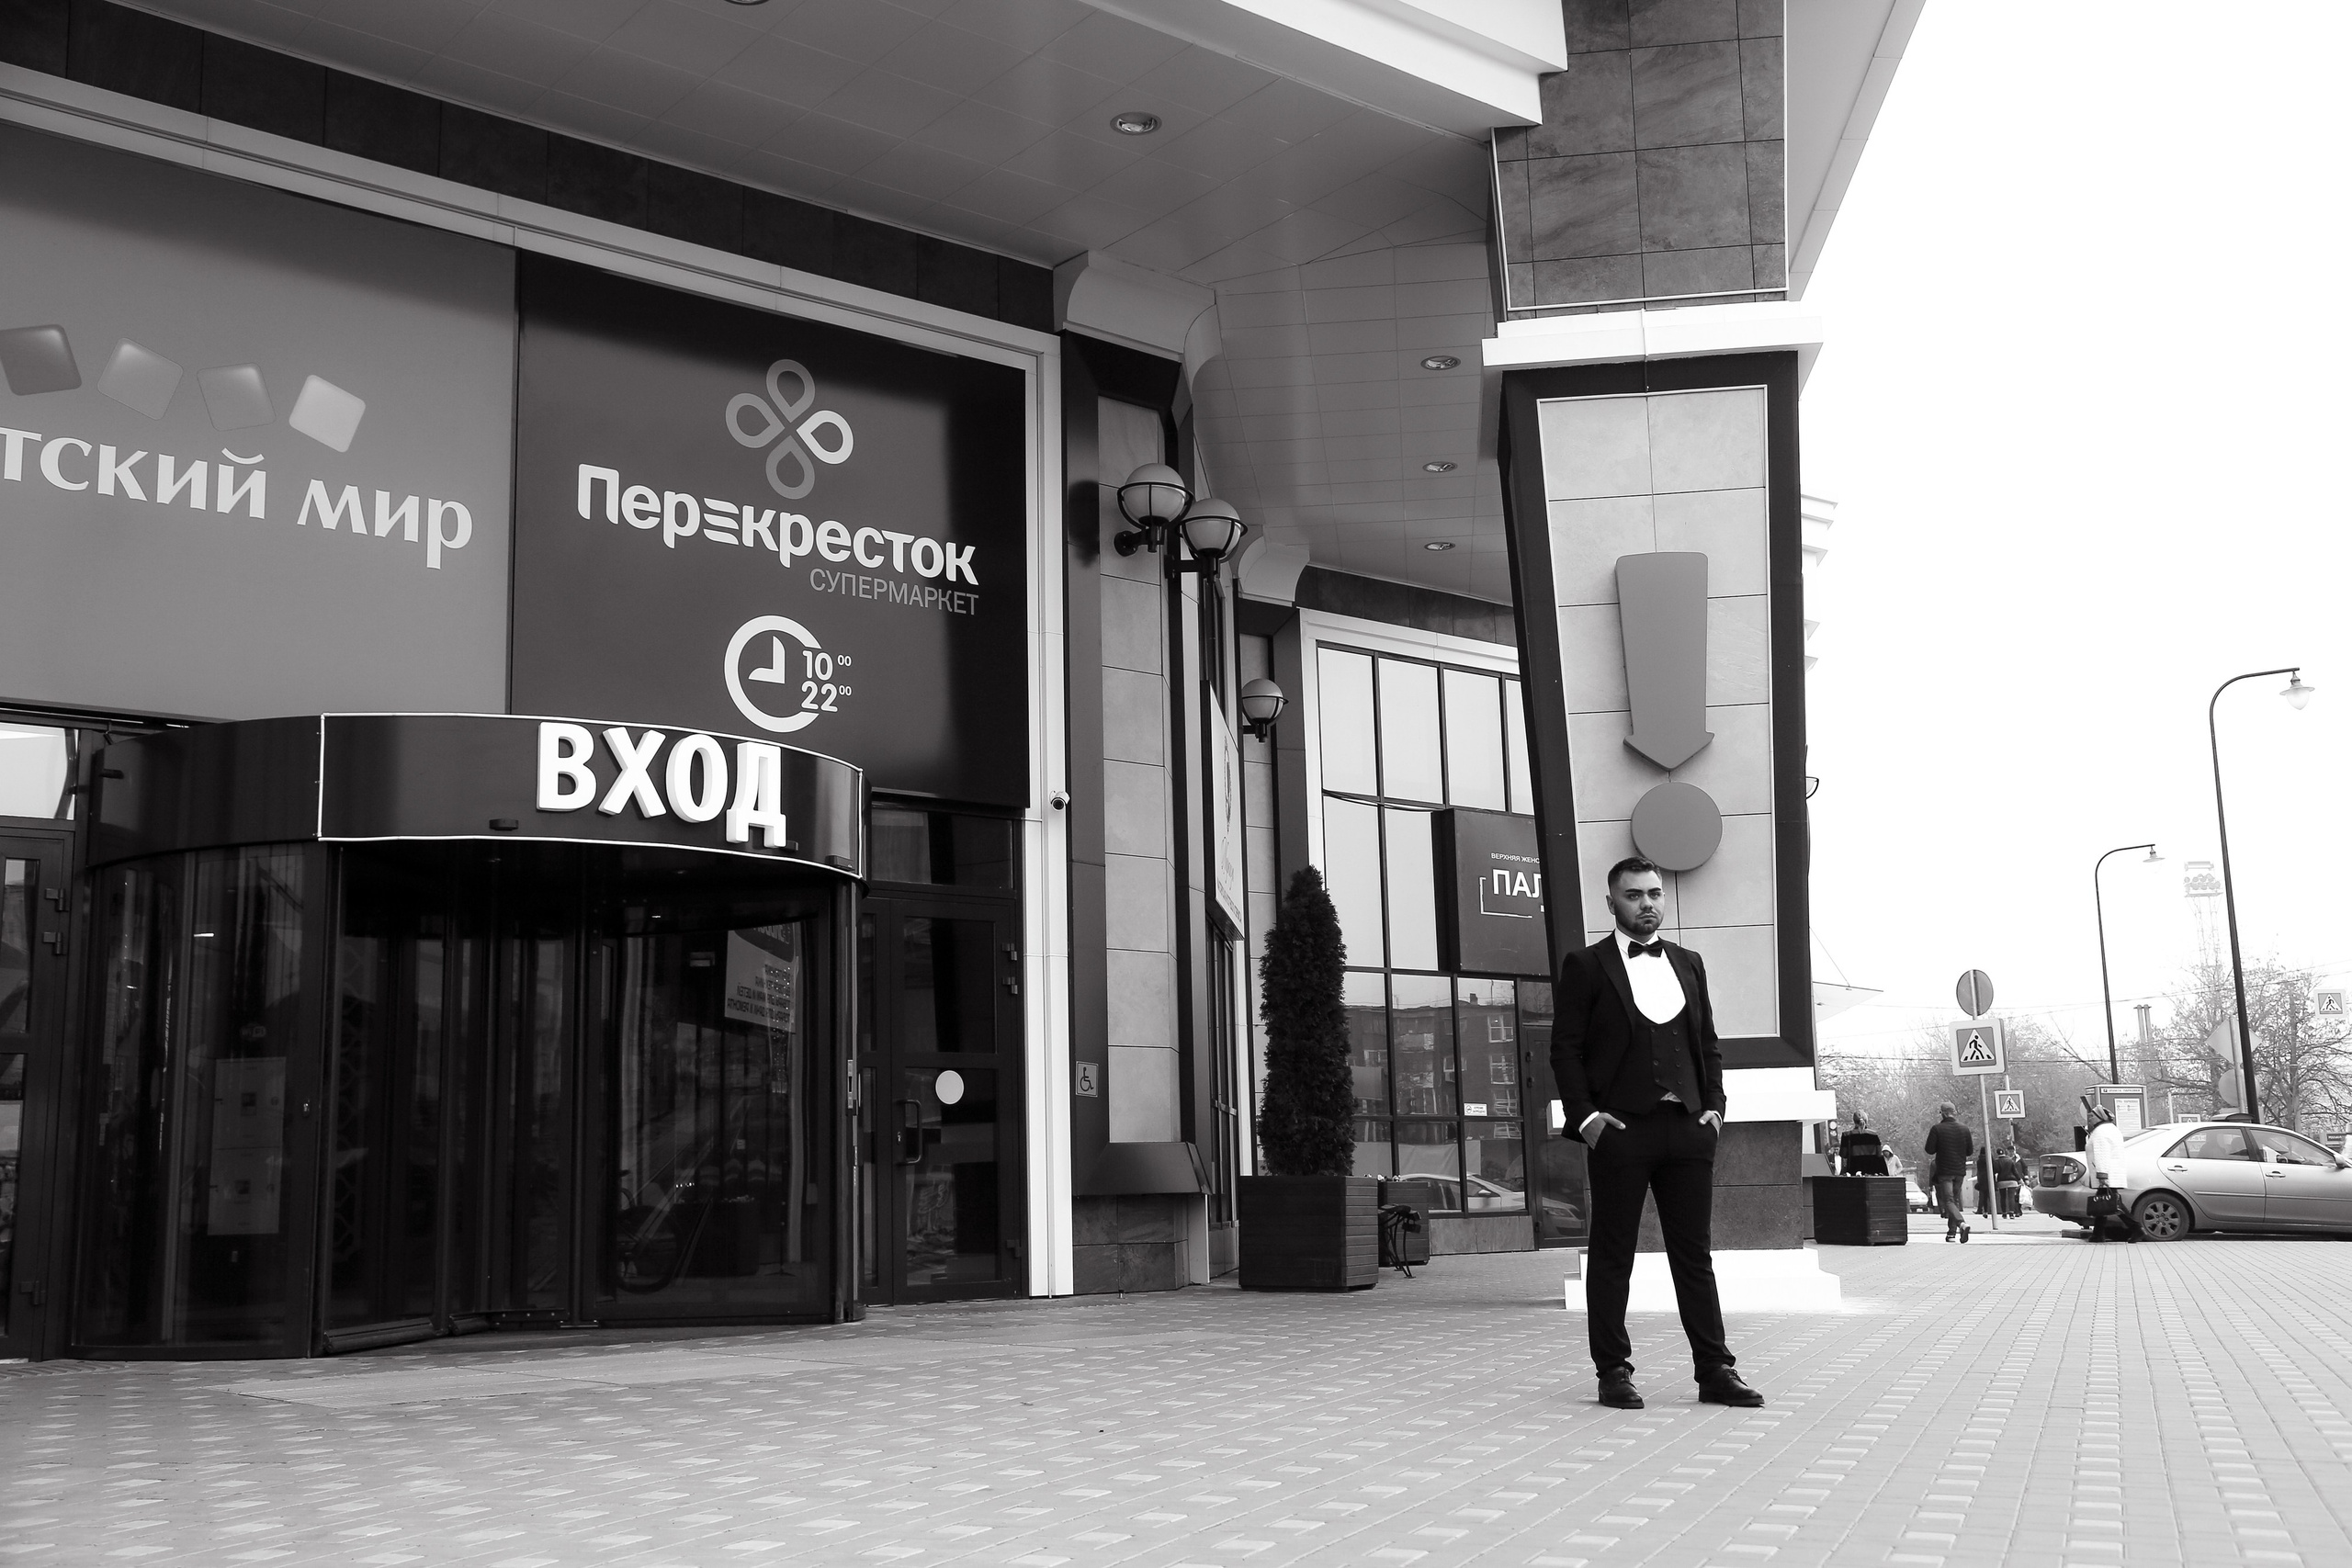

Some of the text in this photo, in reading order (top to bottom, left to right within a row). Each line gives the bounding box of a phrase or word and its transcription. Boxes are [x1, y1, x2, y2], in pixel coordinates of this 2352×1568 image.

[0, 426, 474, 570] тский мир
[809, 568, 979, 615] СУПЕРМАРКЕТ
[537, 722, 786, 848] ВХОД
[1491, 852, 1521, 862] ВЕРХНЯЯ
